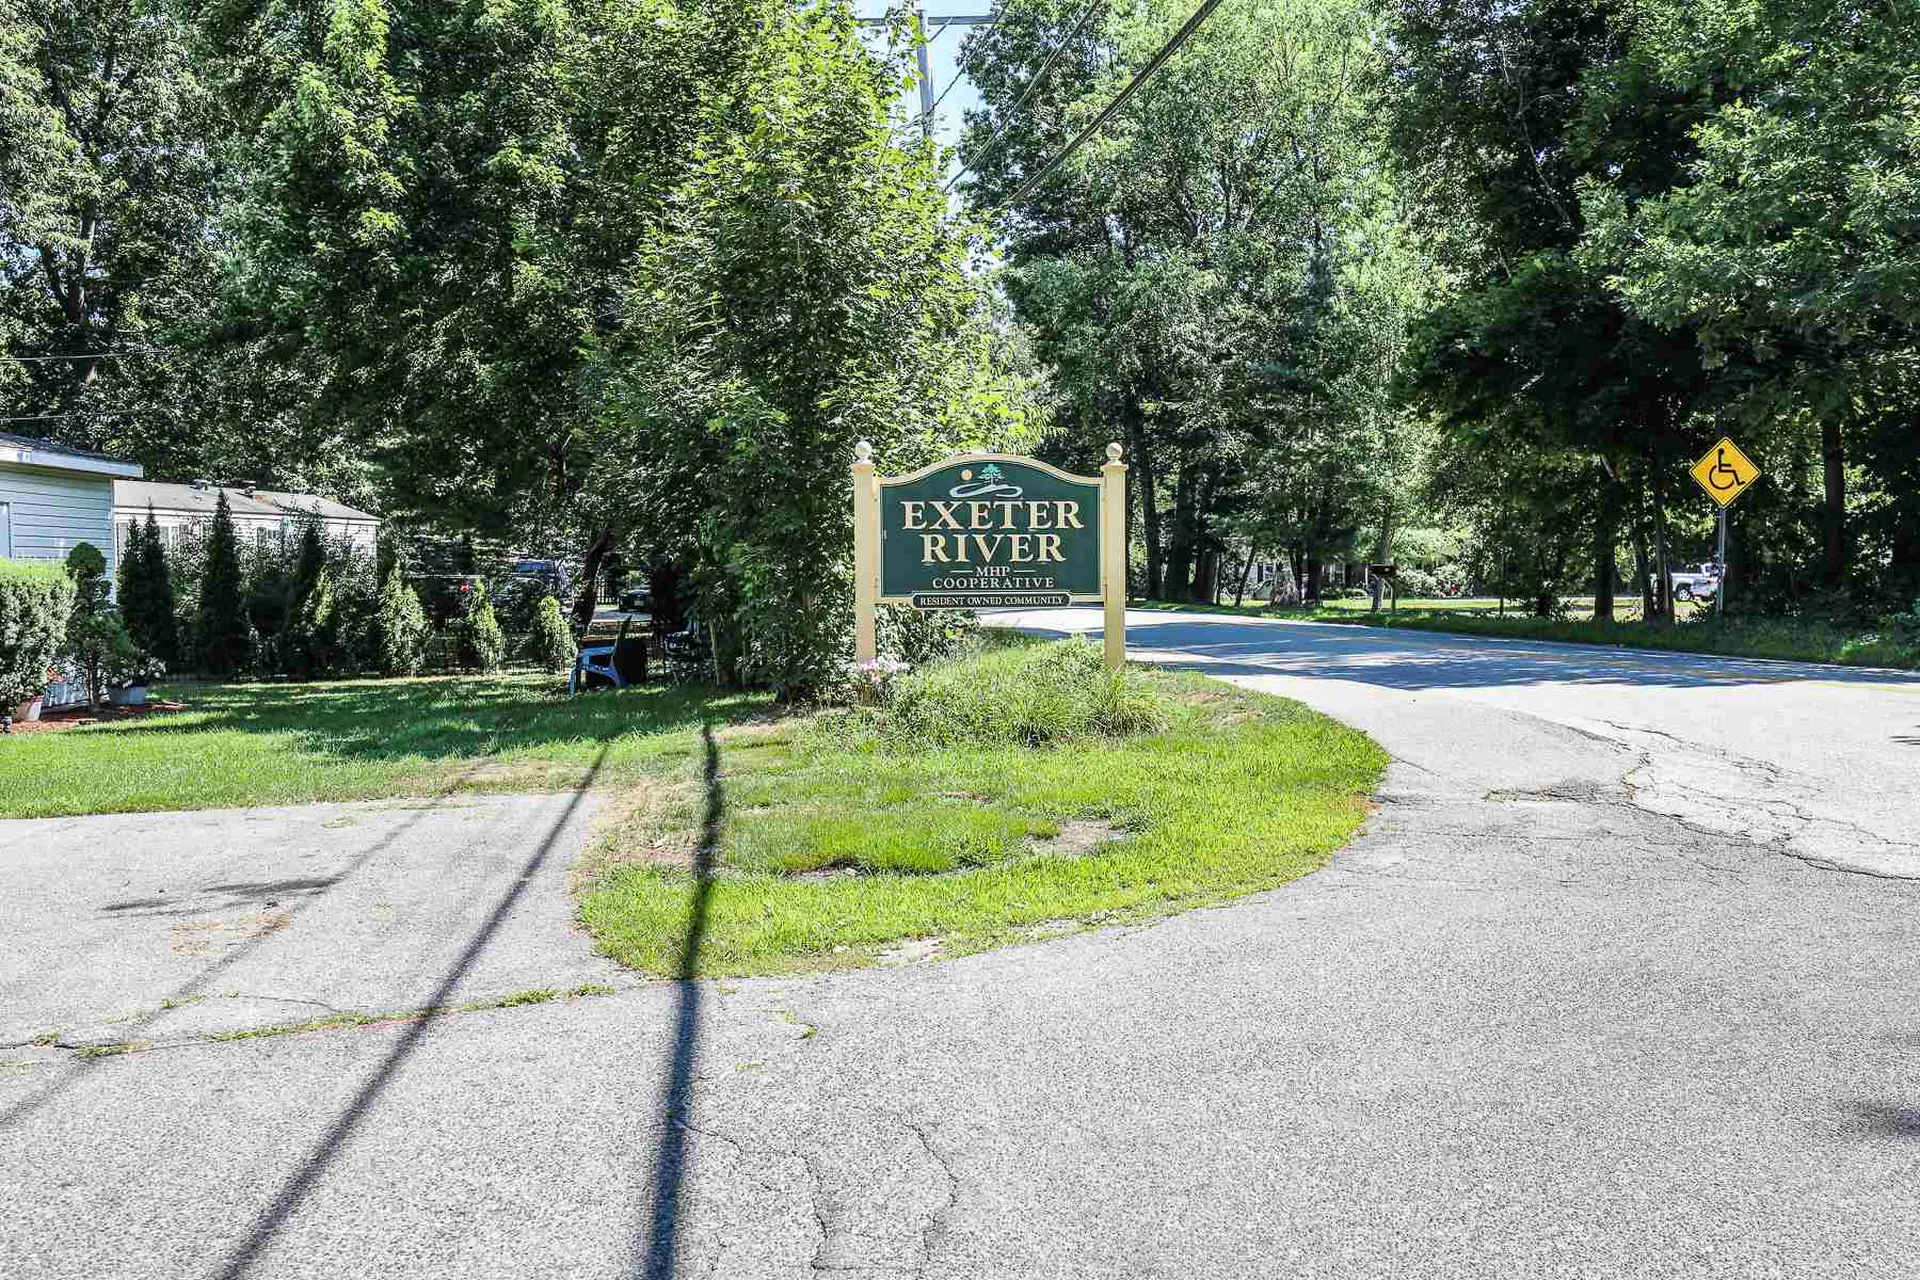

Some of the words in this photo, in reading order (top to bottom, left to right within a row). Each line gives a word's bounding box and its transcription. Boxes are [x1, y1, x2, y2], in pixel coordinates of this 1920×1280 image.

[901, 501, 1084, 530] EXETER
[919, 534, 1067, 563] RIVER
[975, 565, 1011, 577] MHP
[932, 578, 1055, 589] COOPERATIVE
[920, 597, 965, 606] RESIDENT
[967, 597, 1003, 606] OWNED
[1004, 597, 1064, 606] COMMUNITY
